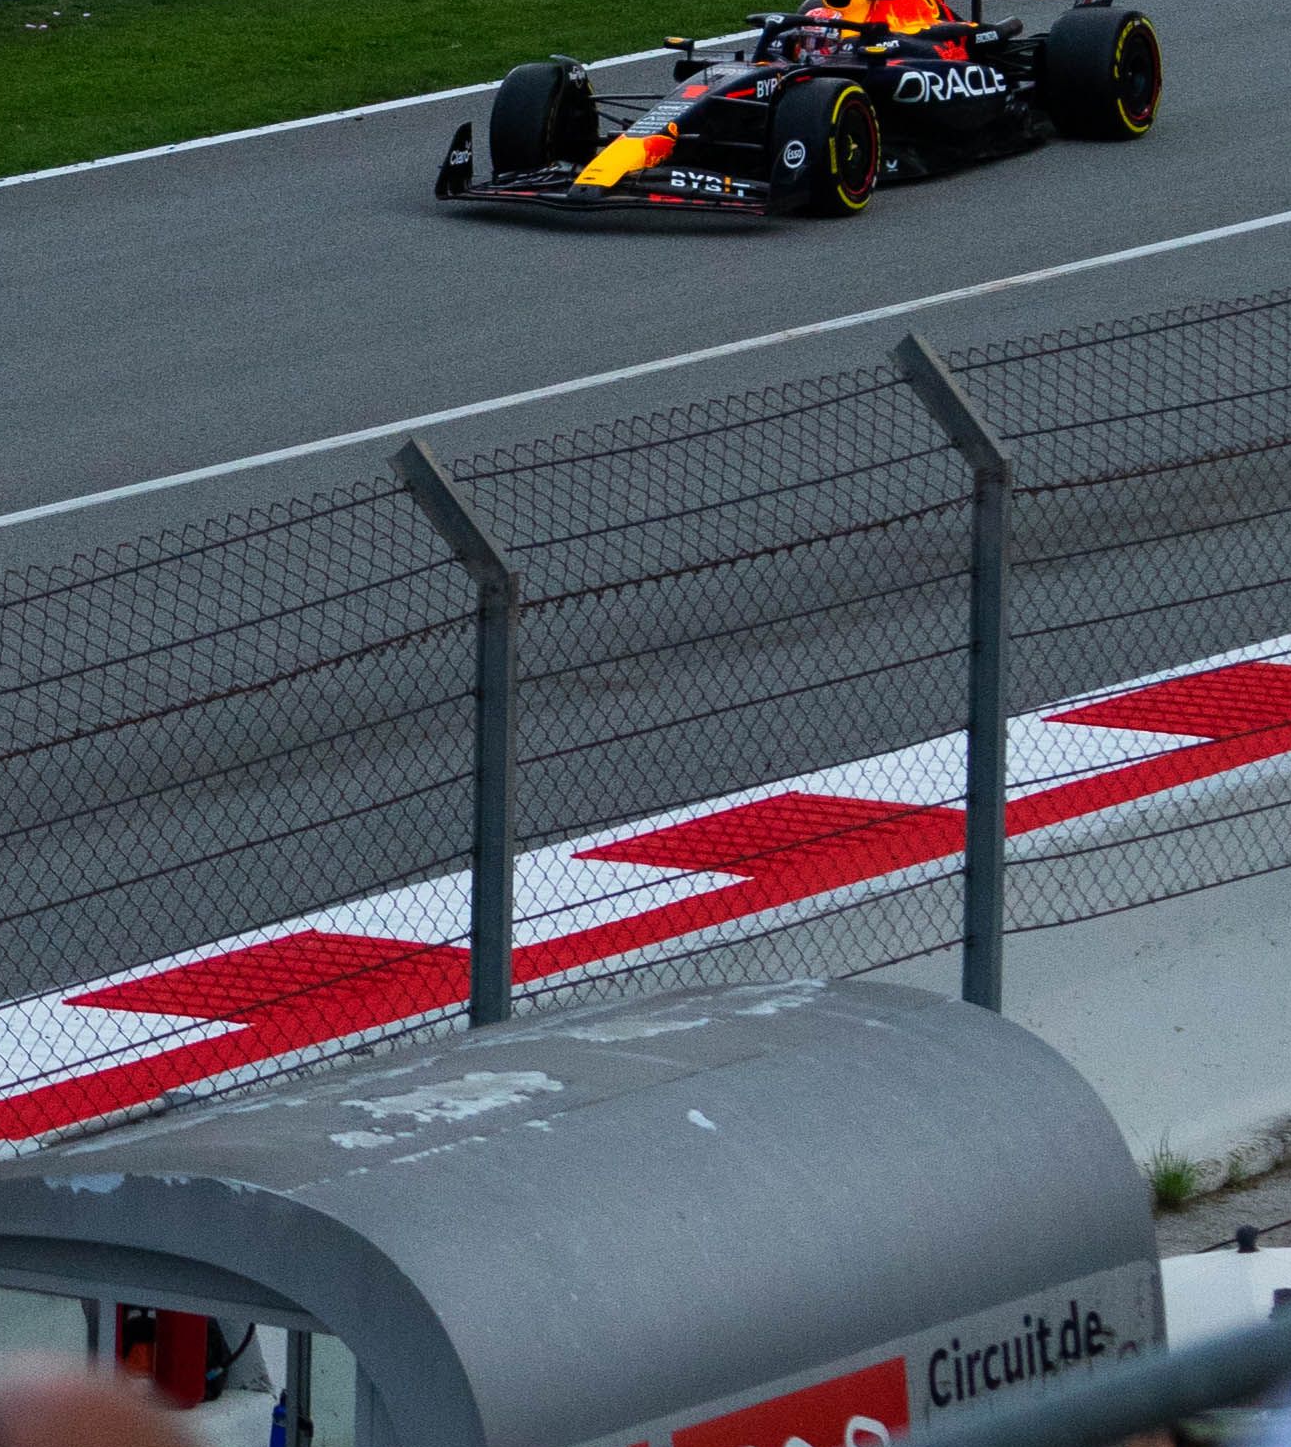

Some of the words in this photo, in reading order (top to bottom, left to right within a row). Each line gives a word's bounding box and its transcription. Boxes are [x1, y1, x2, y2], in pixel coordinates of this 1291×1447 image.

[892, 65, 1007, 103] ORACLE
[929, 1313, 1056, 1407] Circuit
[1060, 1300, 1108, 1360] de
